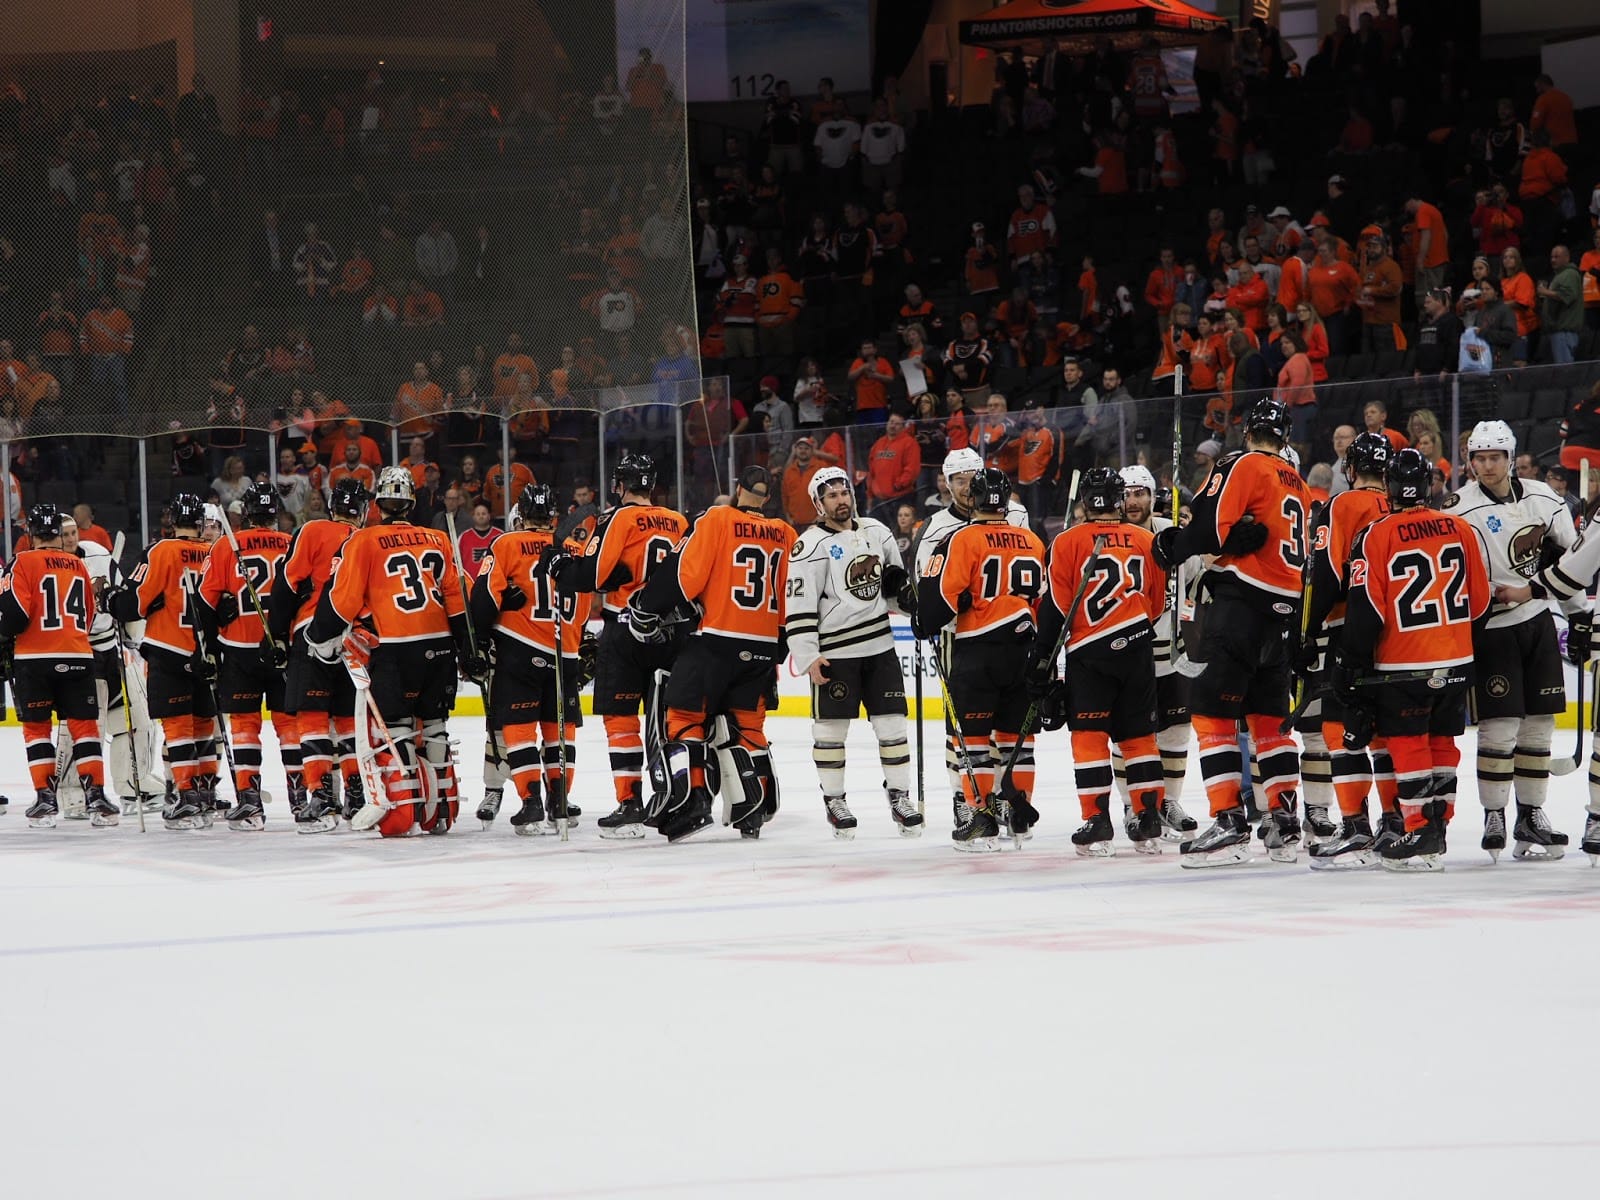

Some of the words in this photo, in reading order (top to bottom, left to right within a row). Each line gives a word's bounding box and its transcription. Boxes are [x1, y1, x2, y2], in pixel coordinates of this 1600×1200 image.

[971, 12, 1137, 36] PHANTOMSHOCKEY.COM
[731, 74, 775, 97] 112
[1269, 409, 1278, 421] 3
[1373, 448, 1387, 461] 23
[641, 475, 648, 486] 6
[1207, 473, 1223, 496] 3
[260, 494, 271, 505] 20
[343, 495, 350, 504] 2
[989, 493, 1000, 505] 18
[1402, 486, 1417, 498] 22
[1094, 496, 1105, 507] 21
[182, 506, 190, 515] 11
[636, 517, 680, 534] SANHEIM
[734, 522, 786, 544] DEKANICH
[1279, 494, 1306, 571] 3
[1398, 518, 1456, 542] CONNER
[378, 532, 442, 549] OUELLETTE
[586, 536, 600, 556] 6
[985, 533, 1033, 550] MARTEL
[45, 557, 81, 571] KNIGHT
[922, 554, 944, 577] 18
[731, 544, 784, 613] 31
[1387, 542, 1471, 632] 22
[786, 578, 804, 597] 32
[1080, 554, 1145, 627] 21
[40, 574, 87, 633] 14
[1128, 629, 1149, 641] CCM
[511, 701, 539, 710] CCM
[1076, 711, 1110, 719] CCM
